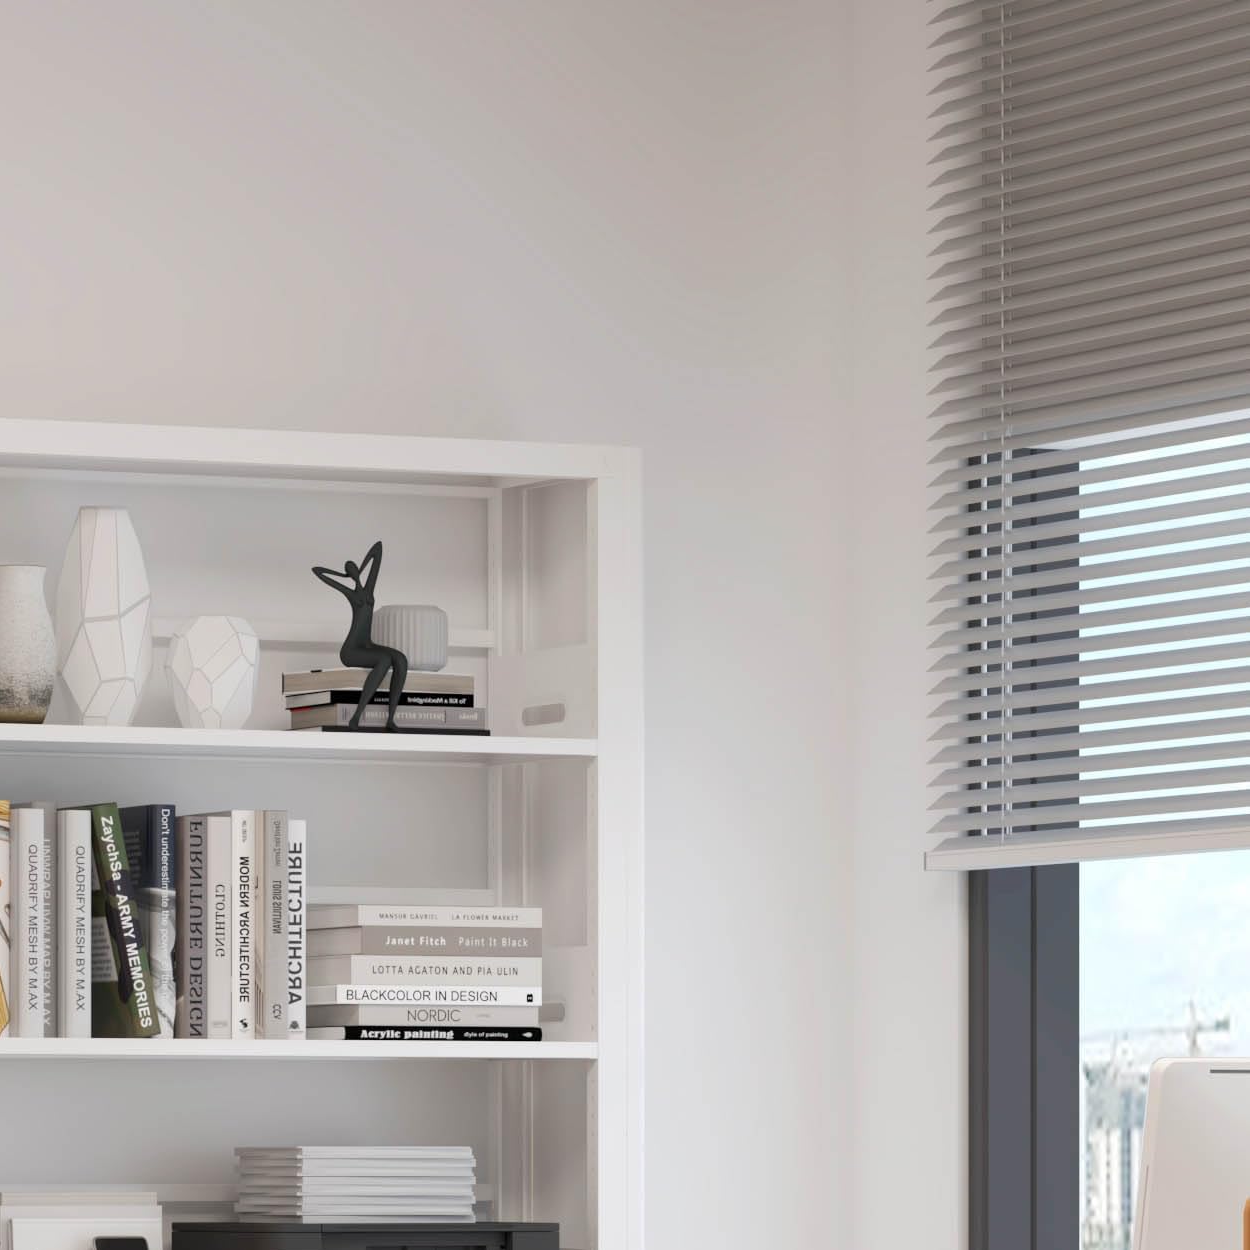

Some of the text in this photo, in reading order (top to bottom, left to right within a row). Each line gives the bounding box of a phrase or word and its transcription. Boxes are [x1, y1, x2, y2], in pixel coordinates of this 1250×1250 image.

[161, 808, 170, 835] Don't
[100, 815, 122, 881] ZaychSa
[161, 837, 170, 908] underestimate
[115, 894, 136, 940] ARMY
[161, 910, 170, 926] the
[379, 912, 407, 920] MANSUR
[28, 844, 38, 1010] QUADRIFY MESH BY M.AX
[76, 846, 85, 1011] QUADRIFY MESH BY M.AX
[385, 936, 446, 946] Janet Fitch
[458, 937, 486, 947] Paint
[501, 937, 529, 948] Black
[372, 965, 519, 976] LOTTA AGATON AND PIA ULIN
[125, 942, 152, 1029] MEMORIES
[346, 989, 498, 1002] BLACKCOLOR IN DESIGN
[407, 1009, 461, 1023] NORDIC
[360, 1029, 454, 1041] Acrylic painting
